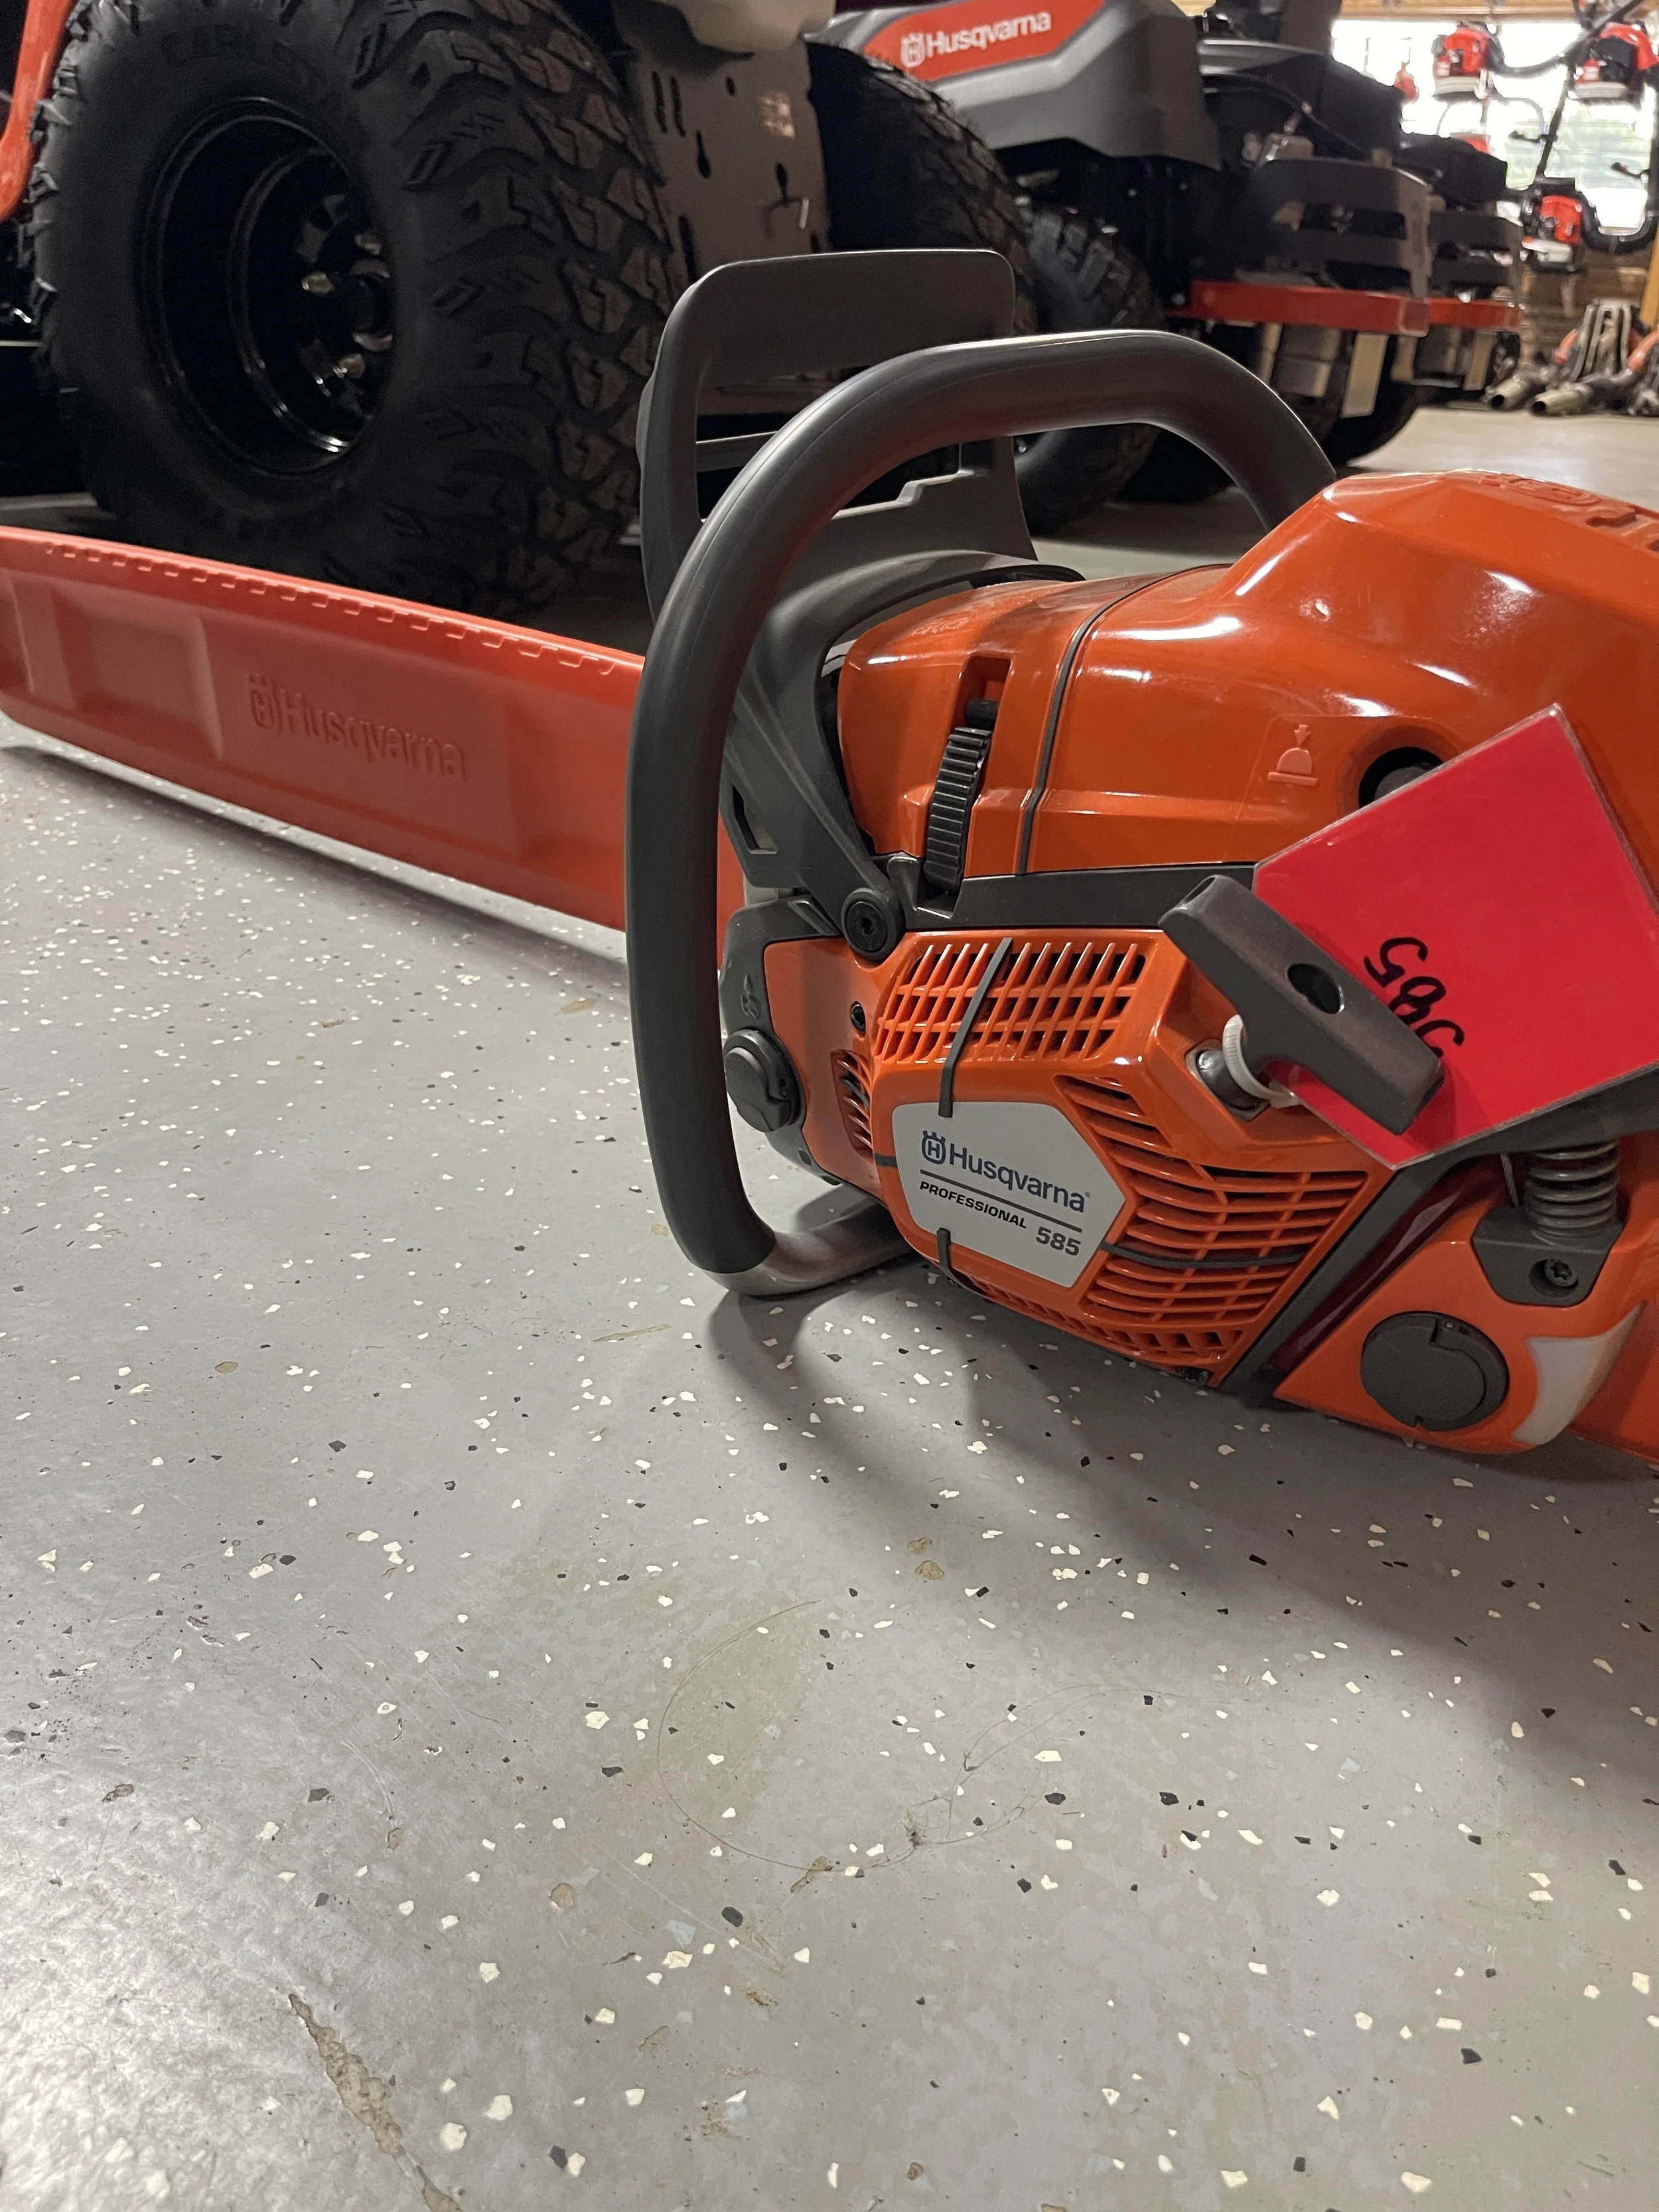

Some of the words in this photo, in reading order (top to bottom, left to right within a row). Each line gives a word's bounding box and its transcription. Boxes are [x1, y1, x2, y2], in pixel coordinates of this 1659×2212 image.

[926, 11, 1052, 58] Husqvarna
[279, 688, 468, 783] Husqvarna
[949, 1142, 1085, 1213] Husqvarna
[919, 1181, 1027, 1229] PROFESSIONAL
[1035, 1226, 1082, 1256] 585
